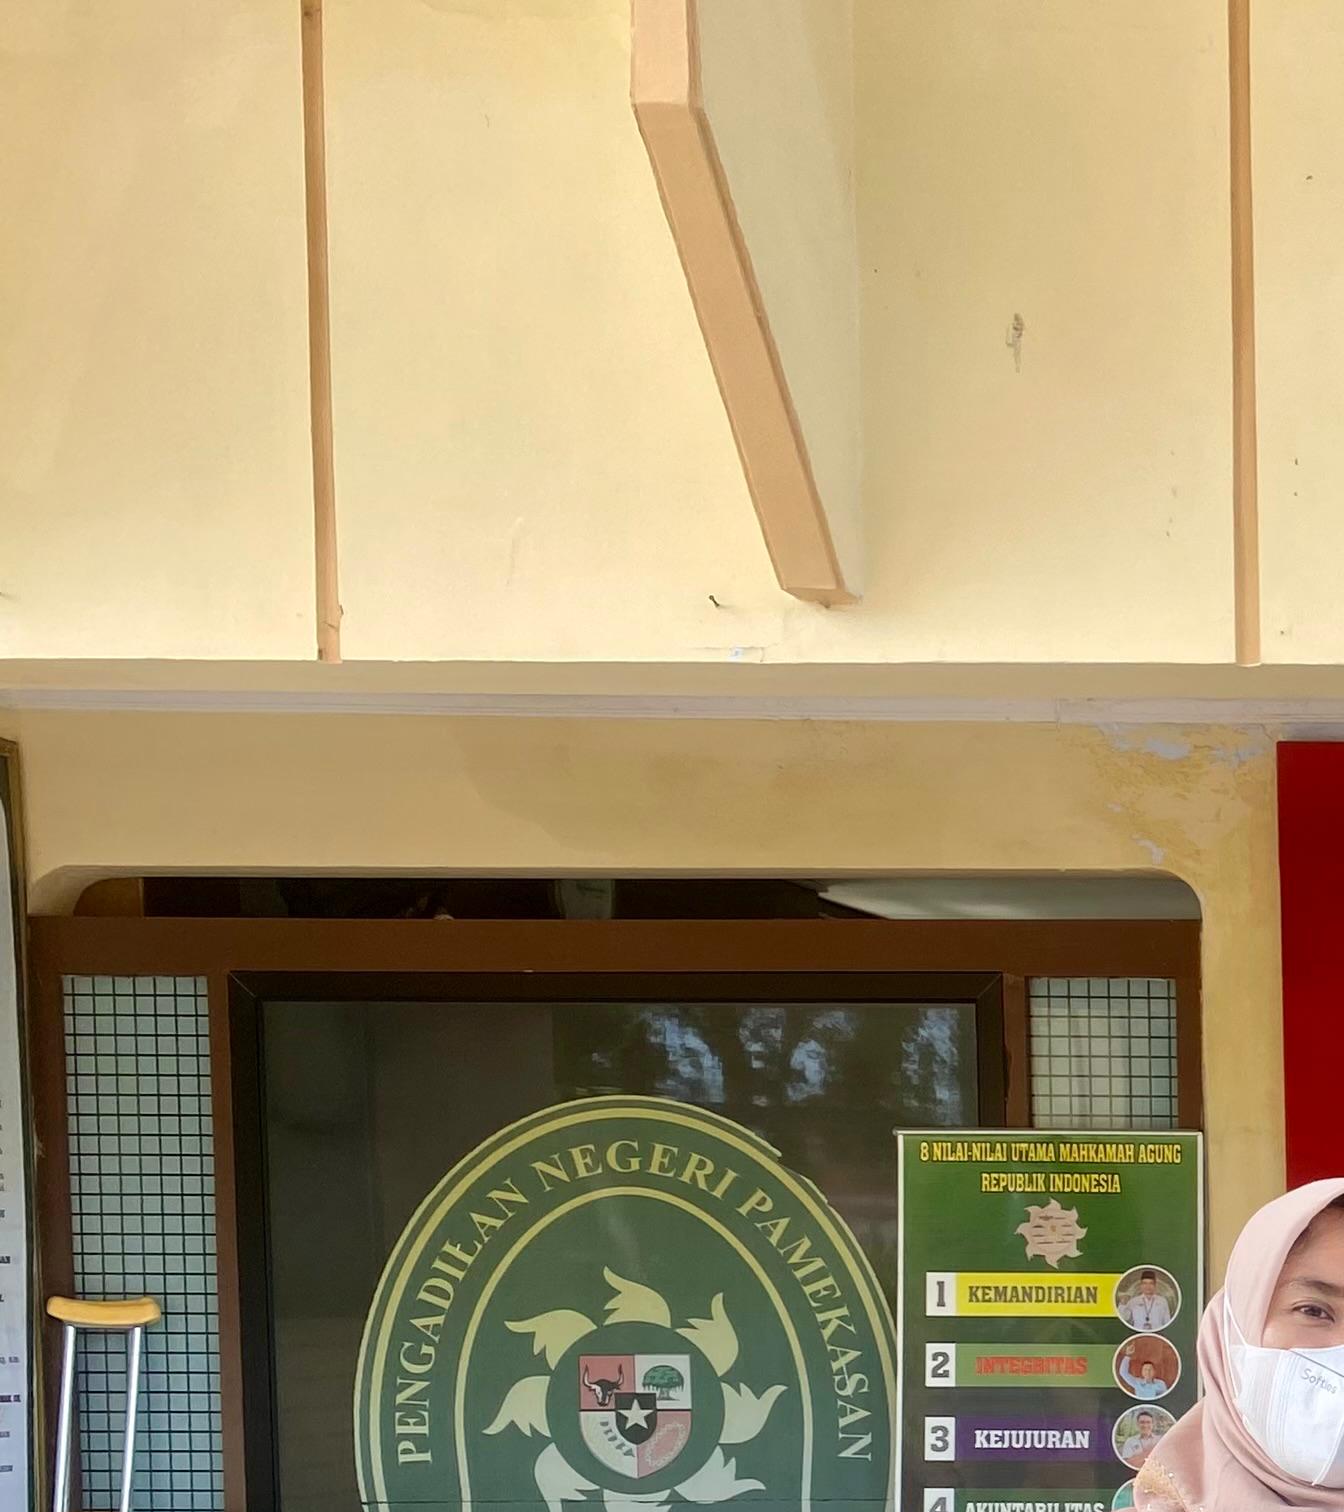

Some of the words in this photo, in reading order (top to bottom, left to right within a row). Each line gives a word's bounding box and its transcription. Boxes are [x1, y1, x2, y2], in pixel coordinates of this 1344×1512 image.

[920, 1142, 929, 1161] 8
[932, 1142, 1008, 1161] NILAI-NILAI
[1011, 1143, 1056, 1162] UTAMA
[1059, 1143, 1135, 1163] MAHKAMAH
[1138, 1144, 1182, 1163] AGUNG
[981, 1173, 1046, 1192] REPUBLIK
[1049, 1173, 1121, 1193] INDONESIA
[395, 1178, 529, 1465] PENGADILAN
[530, 1139, 740, 1199] NEGERI
[736, 1187, 872, 1461] PAMEKASAN
[936, 1281, 946, 1307] 1
[968, 1286, 1098, 1304] KEMANDIRIAN
[931, 1352, 950, 1378] 2
[930, 1425, 949, 1452] 3
[974, 1430, 1090, 1449] KEJUJURAN
